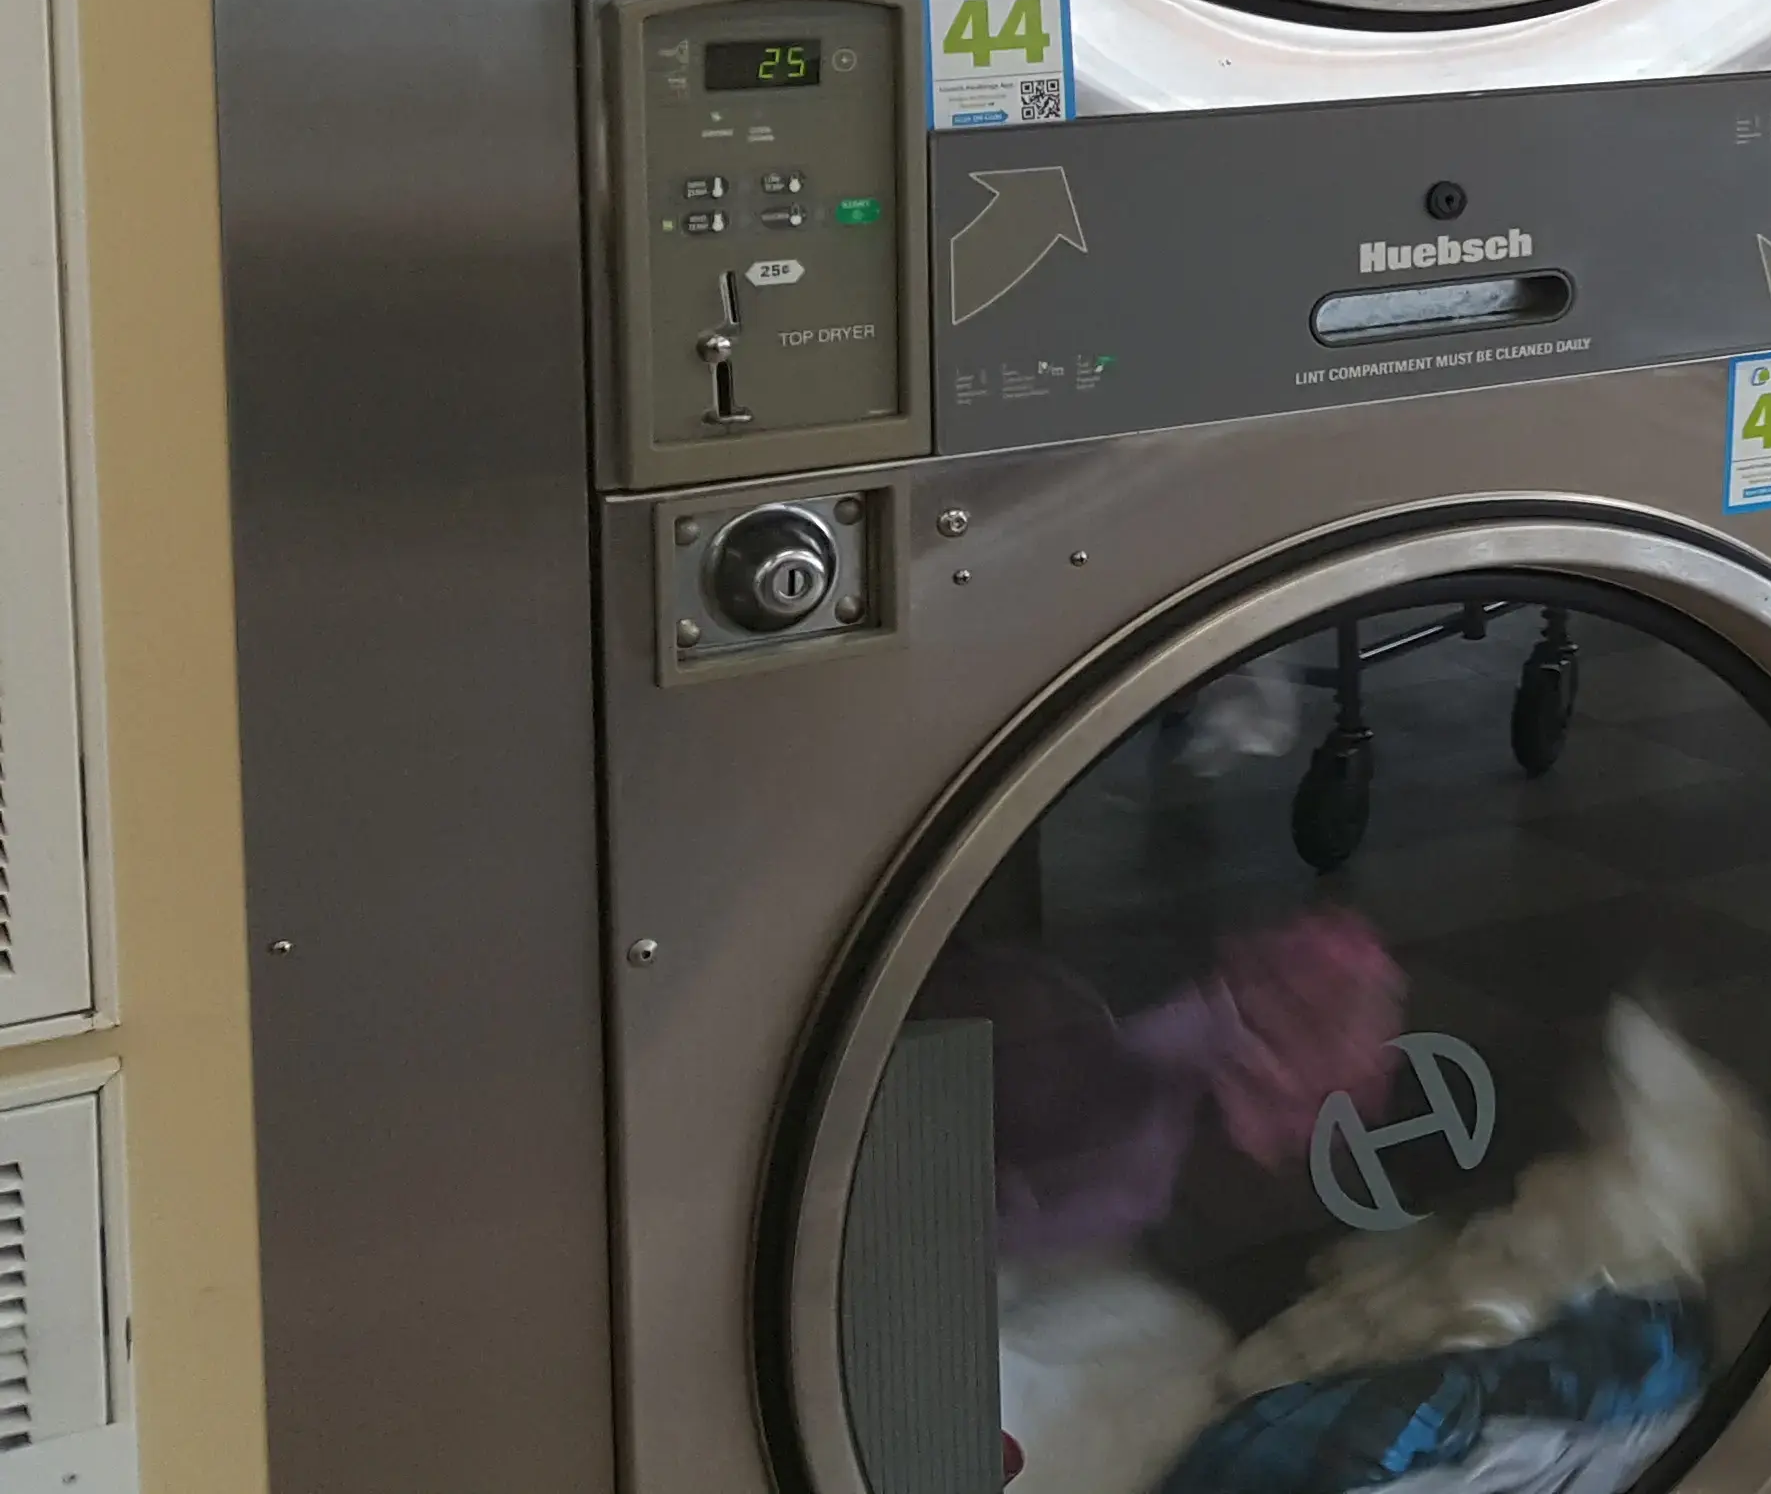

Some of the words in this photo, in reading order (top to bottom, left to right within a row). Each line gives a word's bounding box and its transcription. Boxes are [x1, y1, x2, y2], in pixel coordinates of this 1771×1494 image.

[757, 46, 806, 79] 25
[1359, 228, 1532, 274] Huebsch
[760, 264, 790, 278] 25¢
[779, 330, 813, 346] TOP
[818, 324, 875, 342] DRYER
[1296, 369, 1325, 385] LINT
[1329, 356, 1432, 381] COMPARTMENT
[1436, 351, 1472, 368] MUST
[1476, 350, 1493, 363] BE
[1496, 343, 1552, 362] CLEANED
[1556, 337, 1592, 353] DAILY
